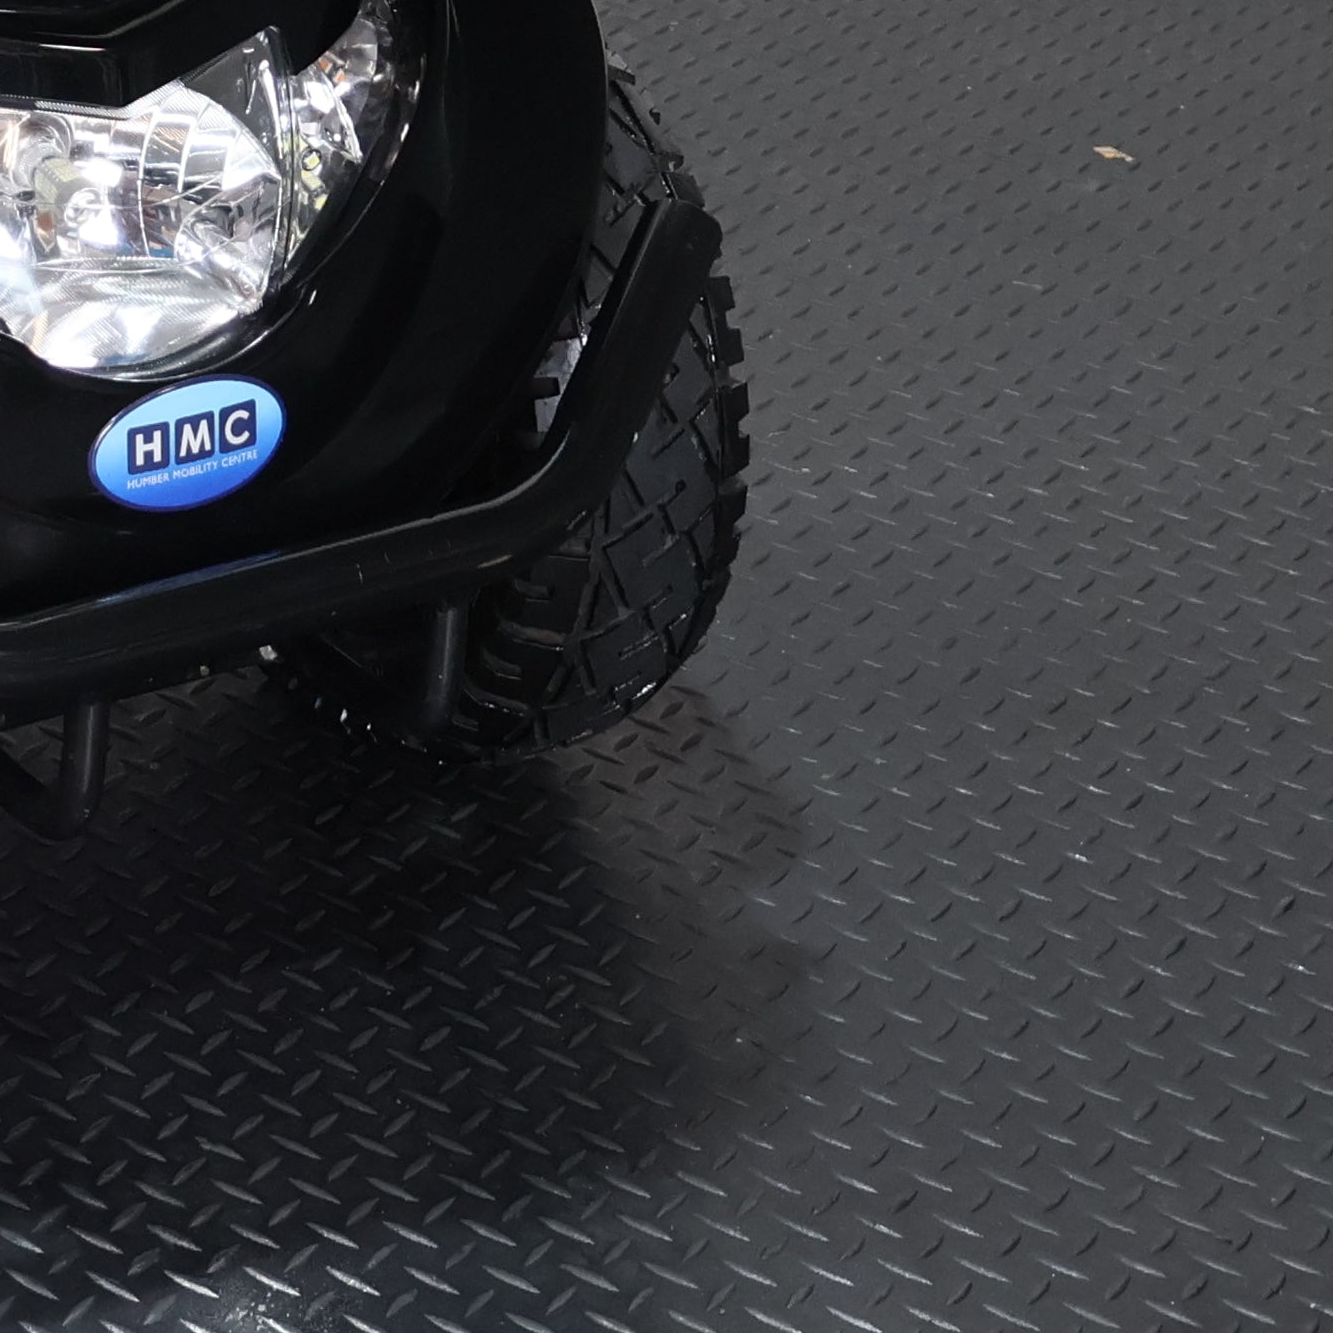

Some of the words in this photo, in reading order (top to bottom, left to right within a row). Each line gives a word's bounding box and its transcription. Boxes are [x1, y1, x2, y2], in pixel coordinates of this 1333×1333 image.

[135, 409, 250, 467] HMC
[127, 473, 170, 489] HUMBER
[172, 461, 218, 479] MOBILITY
[221, 449, 258, 468] CENTRE
